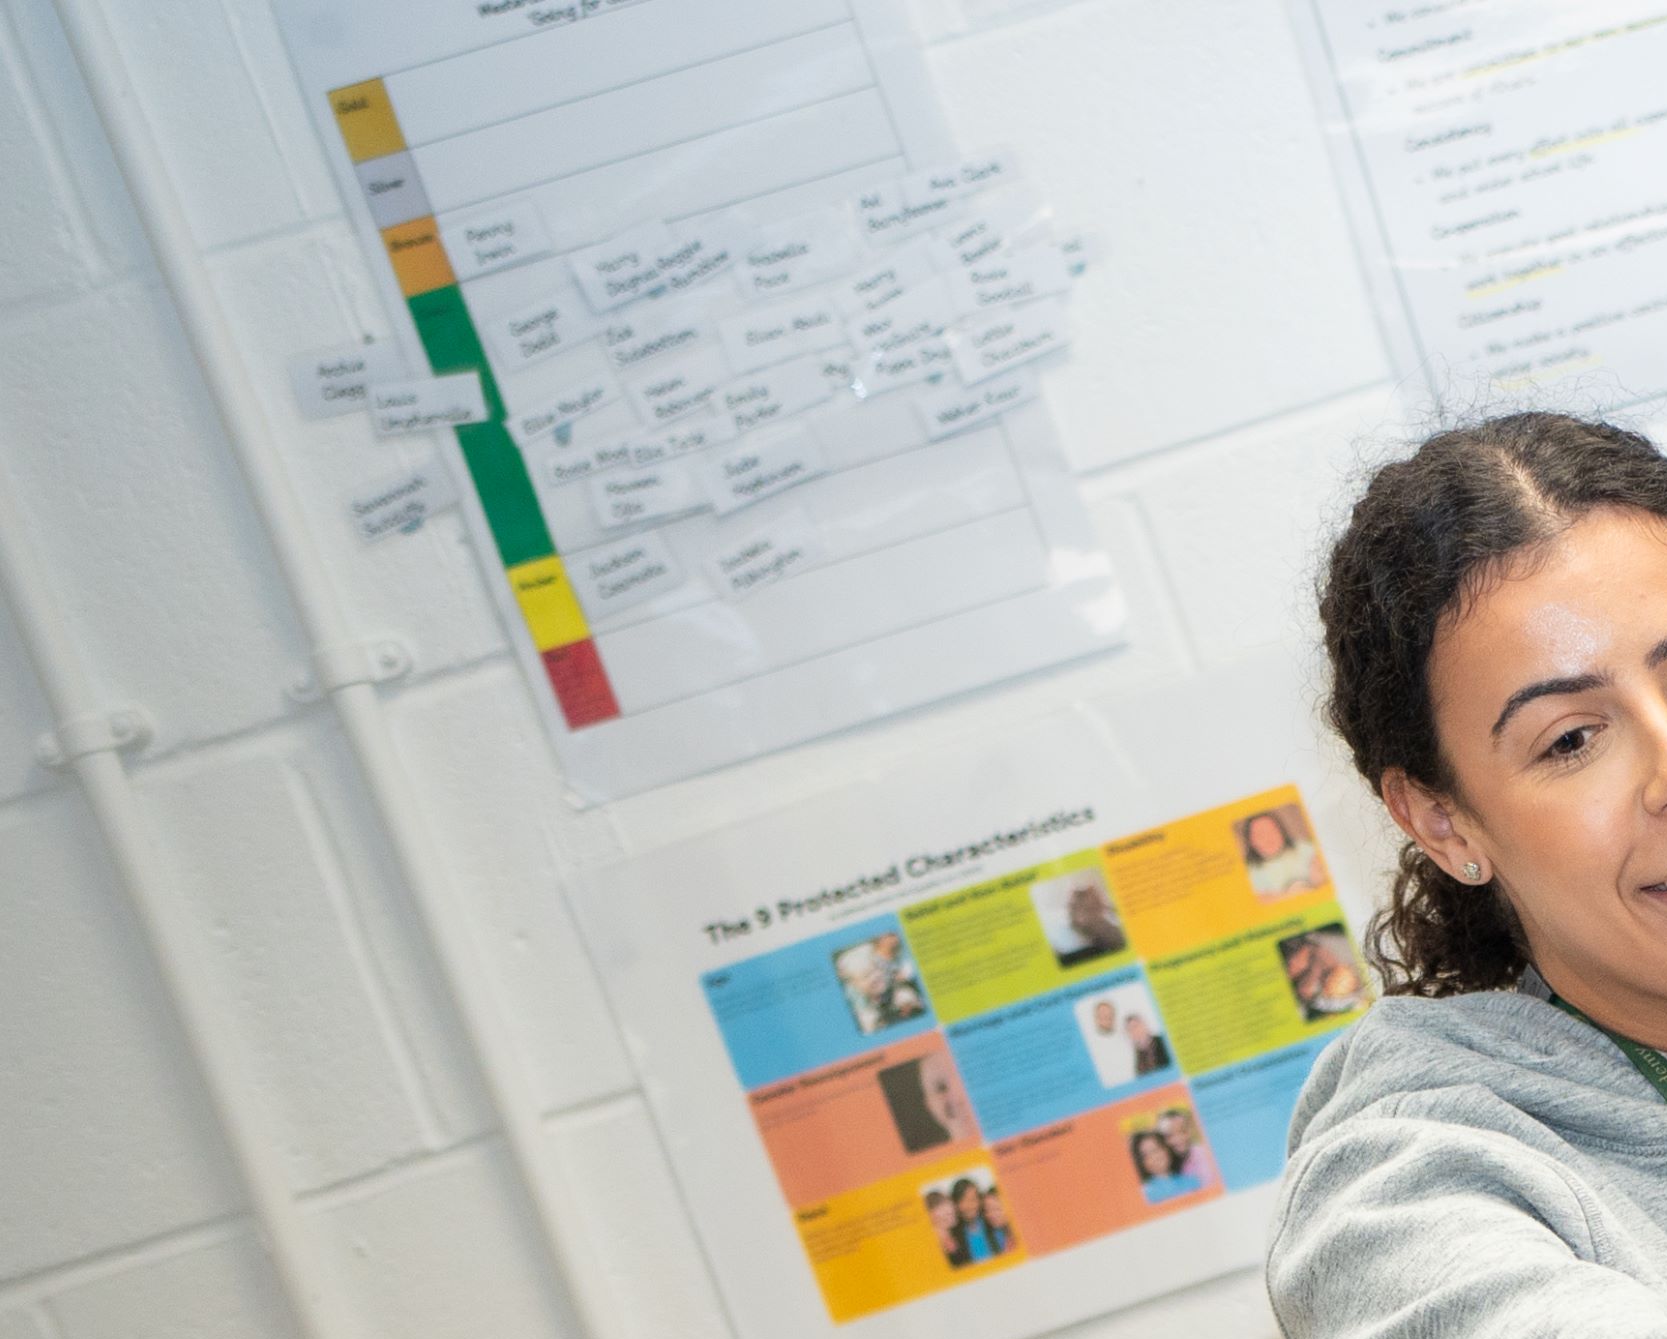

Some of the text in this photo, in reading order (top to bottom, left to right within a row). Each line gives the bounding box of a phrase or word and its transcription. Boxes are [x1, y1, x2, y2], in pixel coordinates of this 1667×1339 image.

[702, 917, 753, 946] The
[756, 908, 772, 929] 9
[777, 865, 901, 921] Protected
[904, 806, 1097, 878] Characteristics
